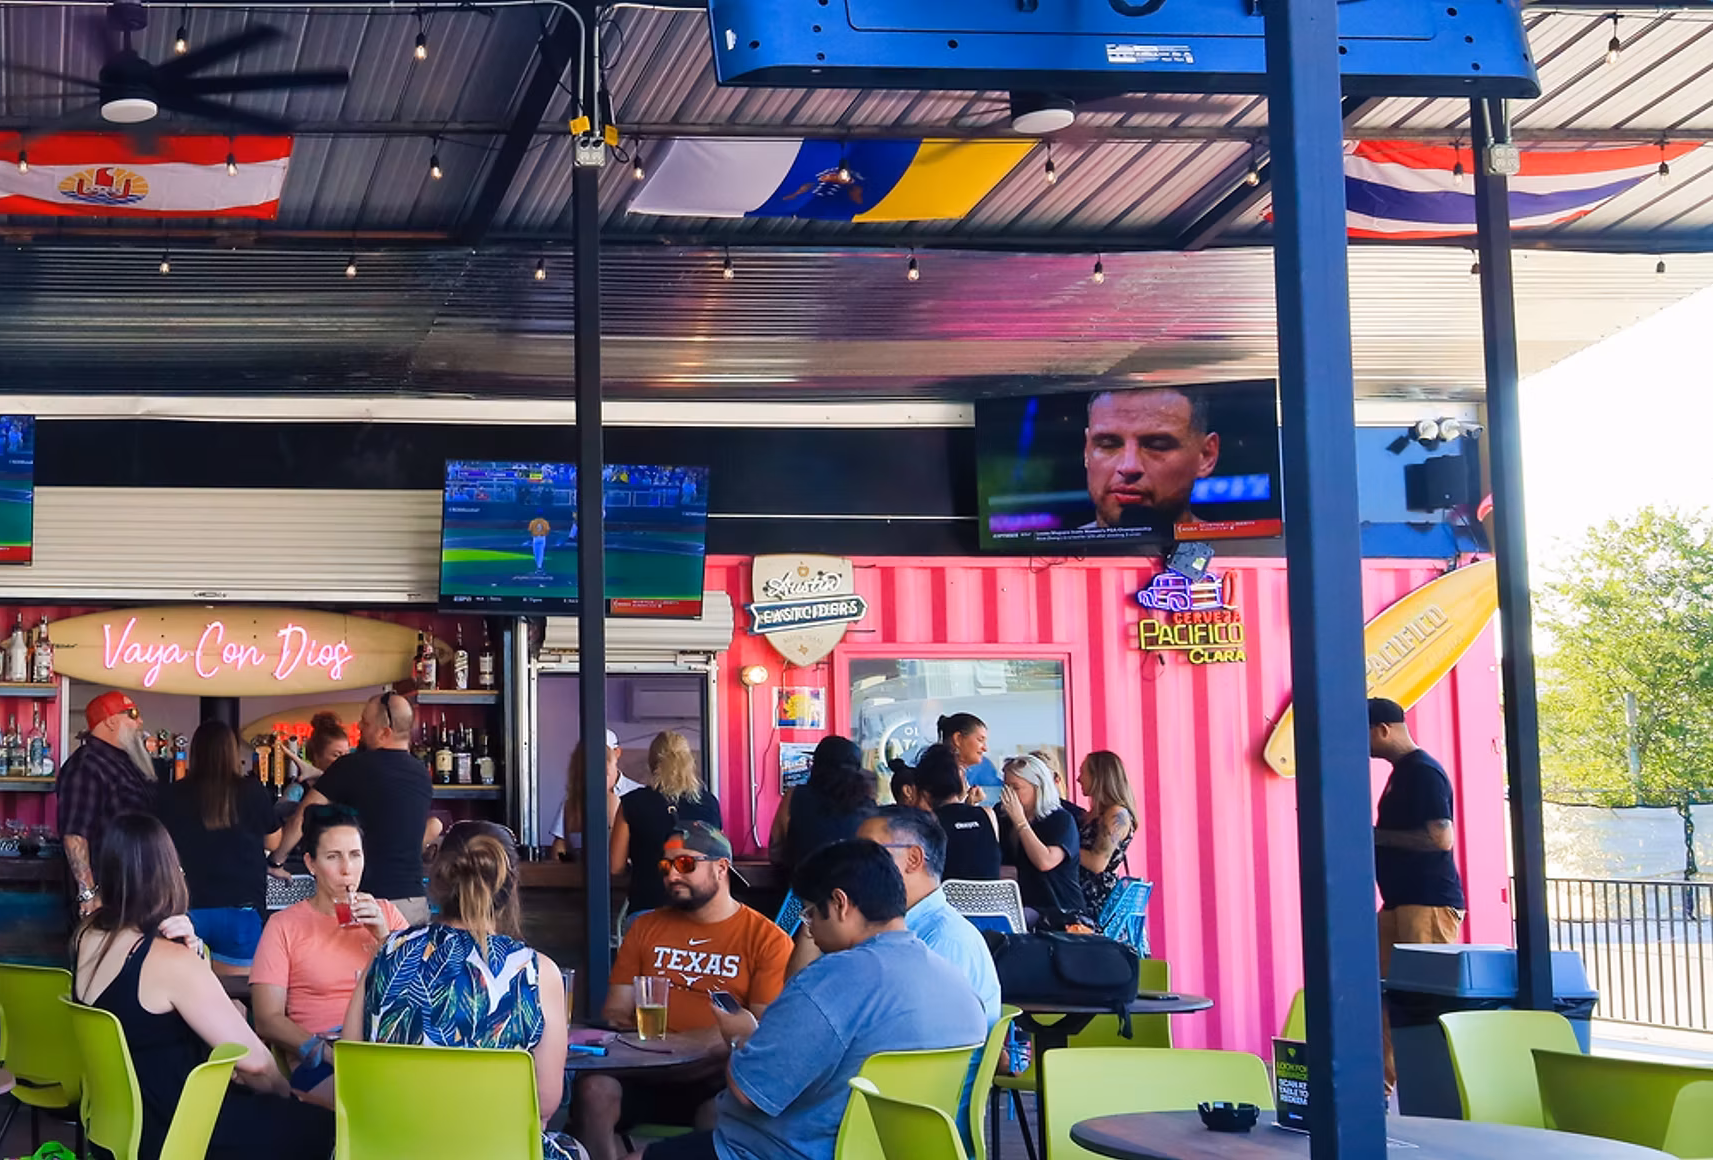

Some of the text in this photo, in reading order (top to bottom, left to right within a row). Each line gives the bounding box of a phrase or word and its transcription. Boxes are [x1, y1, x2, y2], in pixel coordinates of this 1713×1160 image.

[765, 571, 843, 598] Austin
[1173, 611, 1241, 624] CERVEZA
[1139, 618, 1244, 650] PACIFICO
[101, 617, 353, 688] Vaya Con Dios
[654, 946, 740, 978] TEXAS
